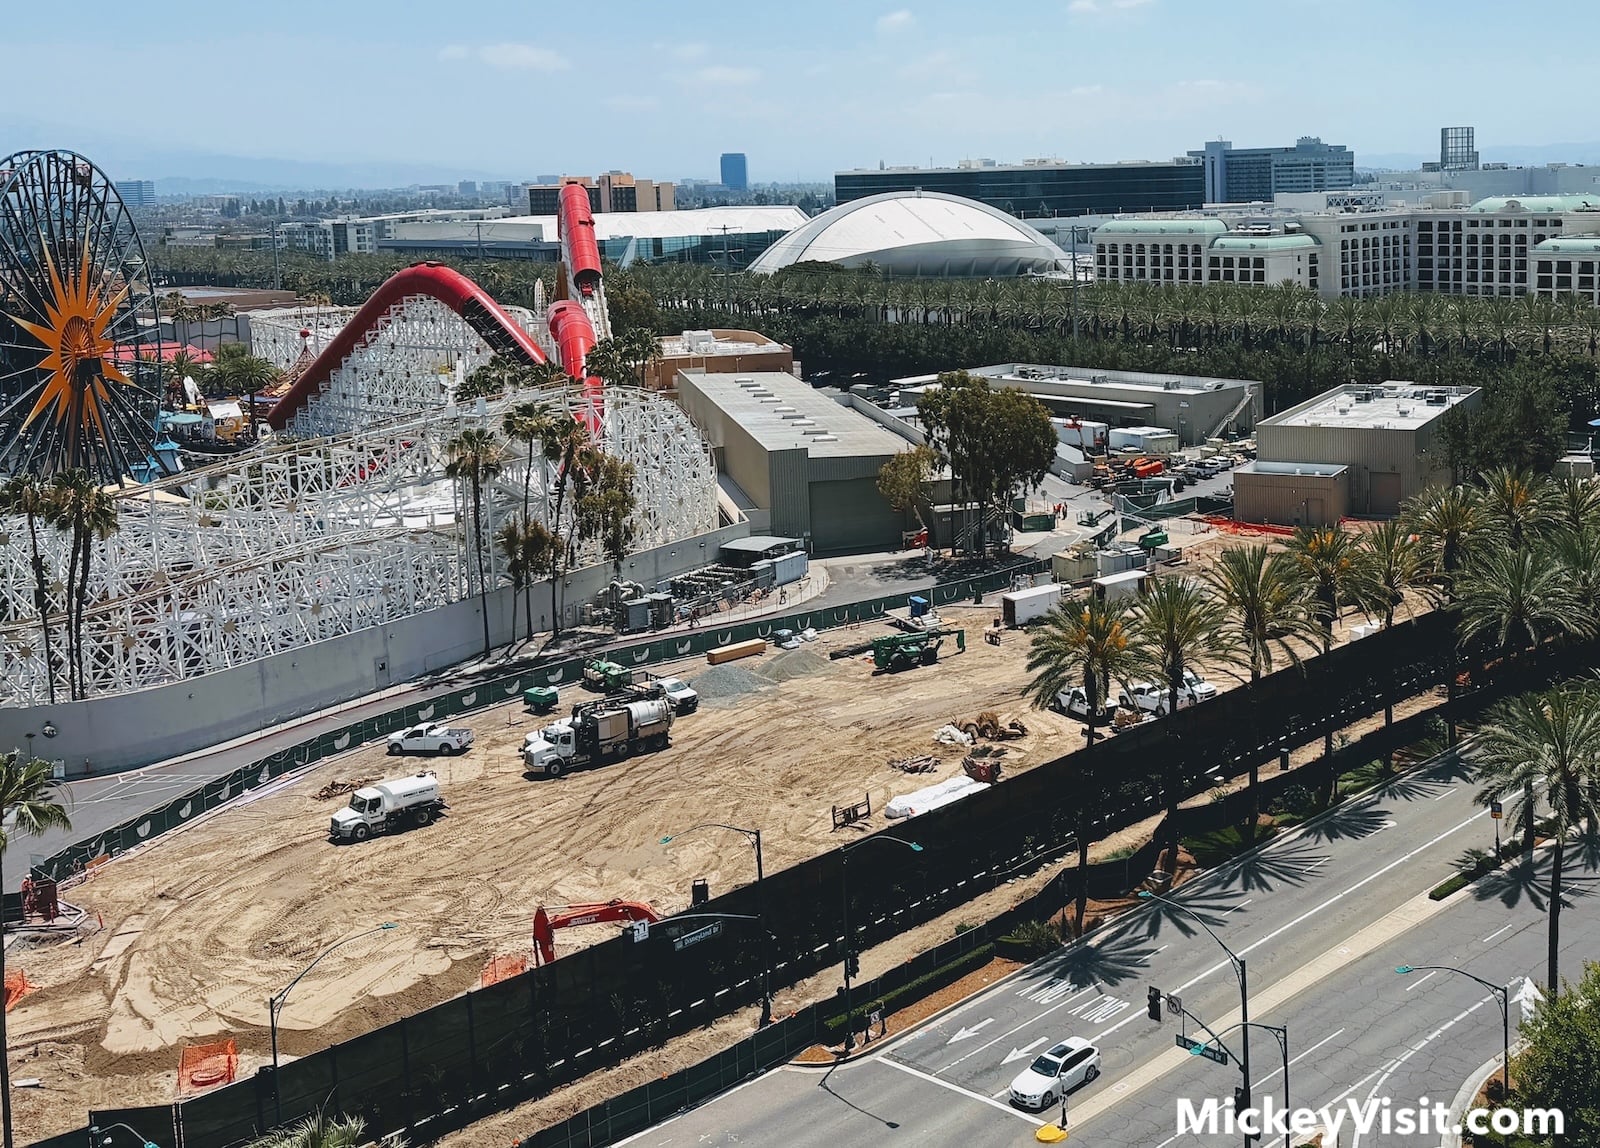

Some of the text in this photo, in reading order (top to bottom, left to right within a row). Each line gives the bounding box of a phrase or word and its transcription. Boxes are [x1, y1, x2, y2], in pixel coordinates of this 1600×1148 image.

[684, 928, 712, 945] Disneyland
[1015, 976, 1078, 1004] ONLY
[1067, 993, 1130, 1023] ONLY
